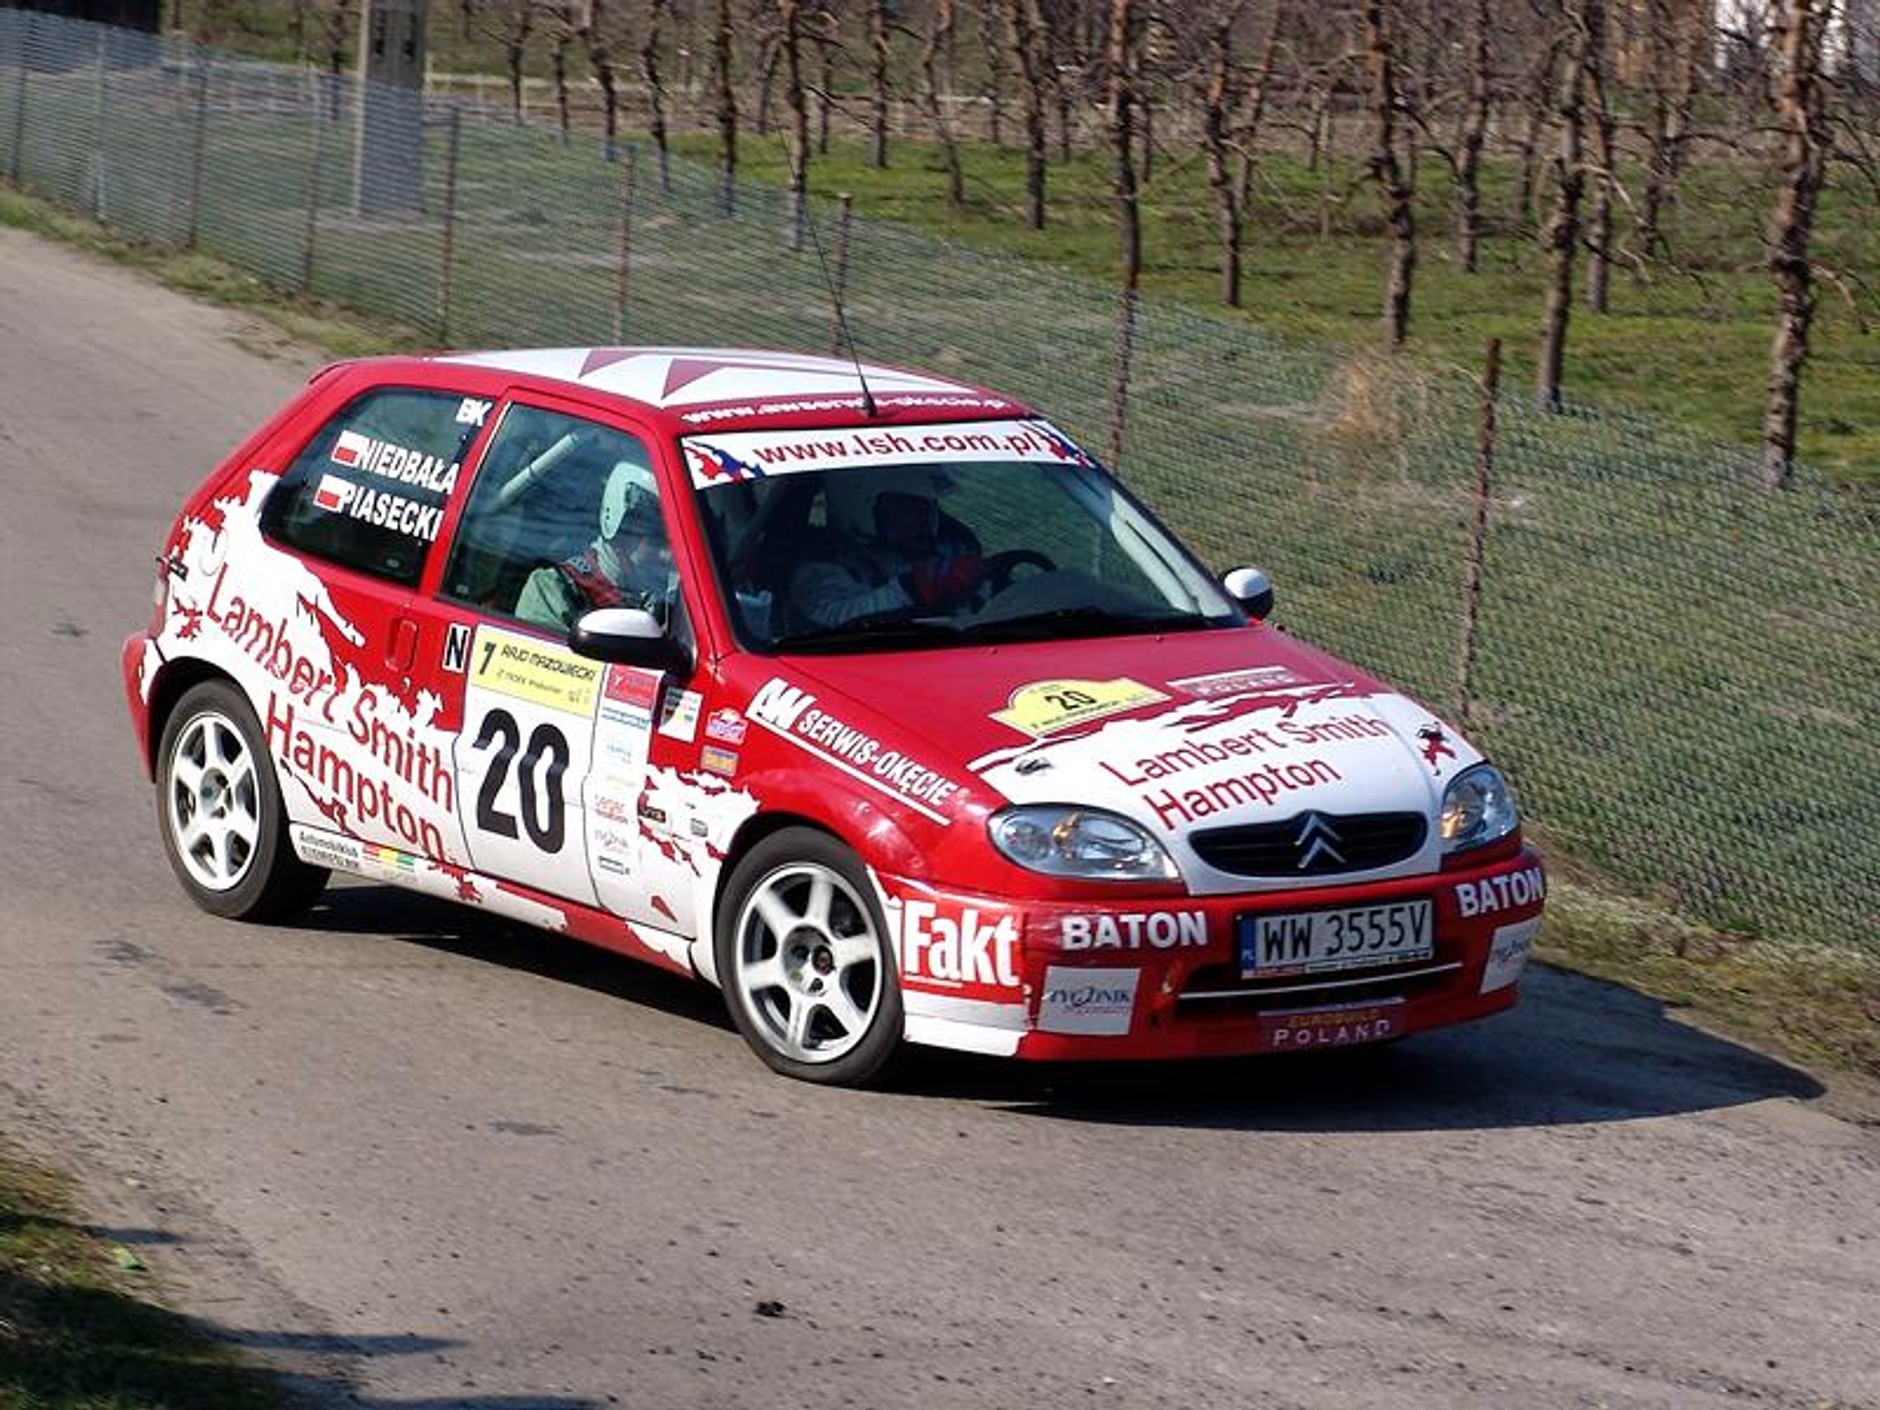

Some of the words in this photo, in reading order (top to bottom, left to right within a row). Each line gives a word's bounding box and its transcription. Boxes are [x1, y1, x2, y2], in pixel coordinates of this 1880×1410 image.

[456, 397, 492, 427] BK
[355, 438, 460, 495] NIEDBAŁA
[752, 430, 1041, 465] www.lsh.com.pl
[339, 484, 445, 542] PIASECKI
[445, 627, 469, 669] N
[206, 561, 350, 723] Lambert
[348, 688, 453, 813] Smith
[1044, 690, 1098, 711] 20
[264, 691, 446, 865] Hampton
[1099, 725, 1286, 787] Lambert
[1282, 712, 1391, 744] Smith
[471, 707, 570, 854] 20
[1143, 756, 1343, 831] Hampton
[1455, 867, 1544, 918] BATON
[903, 900, 1021, 987] Fakt
[1061, 911, 1208, 950] BATON
[1263, 916, 1313, 962] WW
[1325, 902, 1428, 957] 3555V
[1273, 1019, 1391, 1048] POLAND
